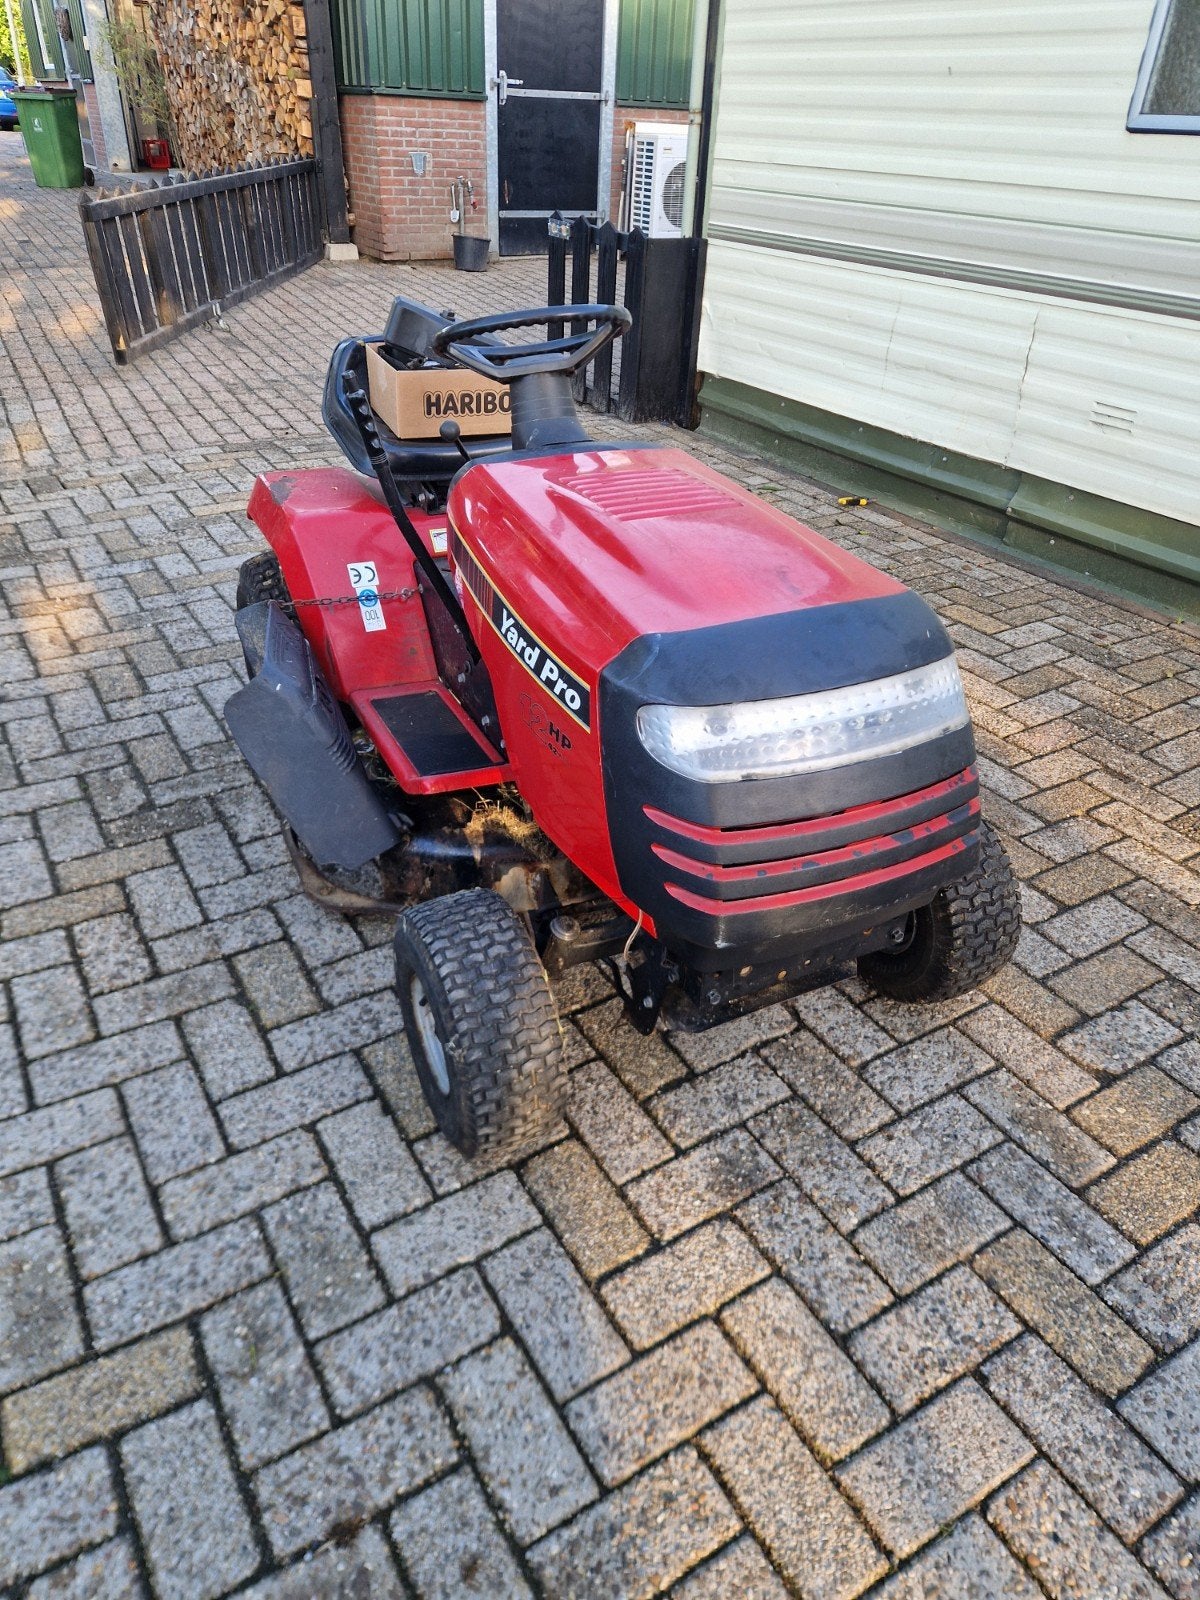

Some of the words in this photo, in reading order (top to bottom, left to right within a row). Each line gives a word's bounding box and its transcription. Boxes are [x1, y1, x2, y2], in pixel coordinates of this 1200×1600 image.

[423, 390, 511, 418] HARIBO
[500, 608, 540, 669] Yard
[540, 658, 581, 711] Pro
